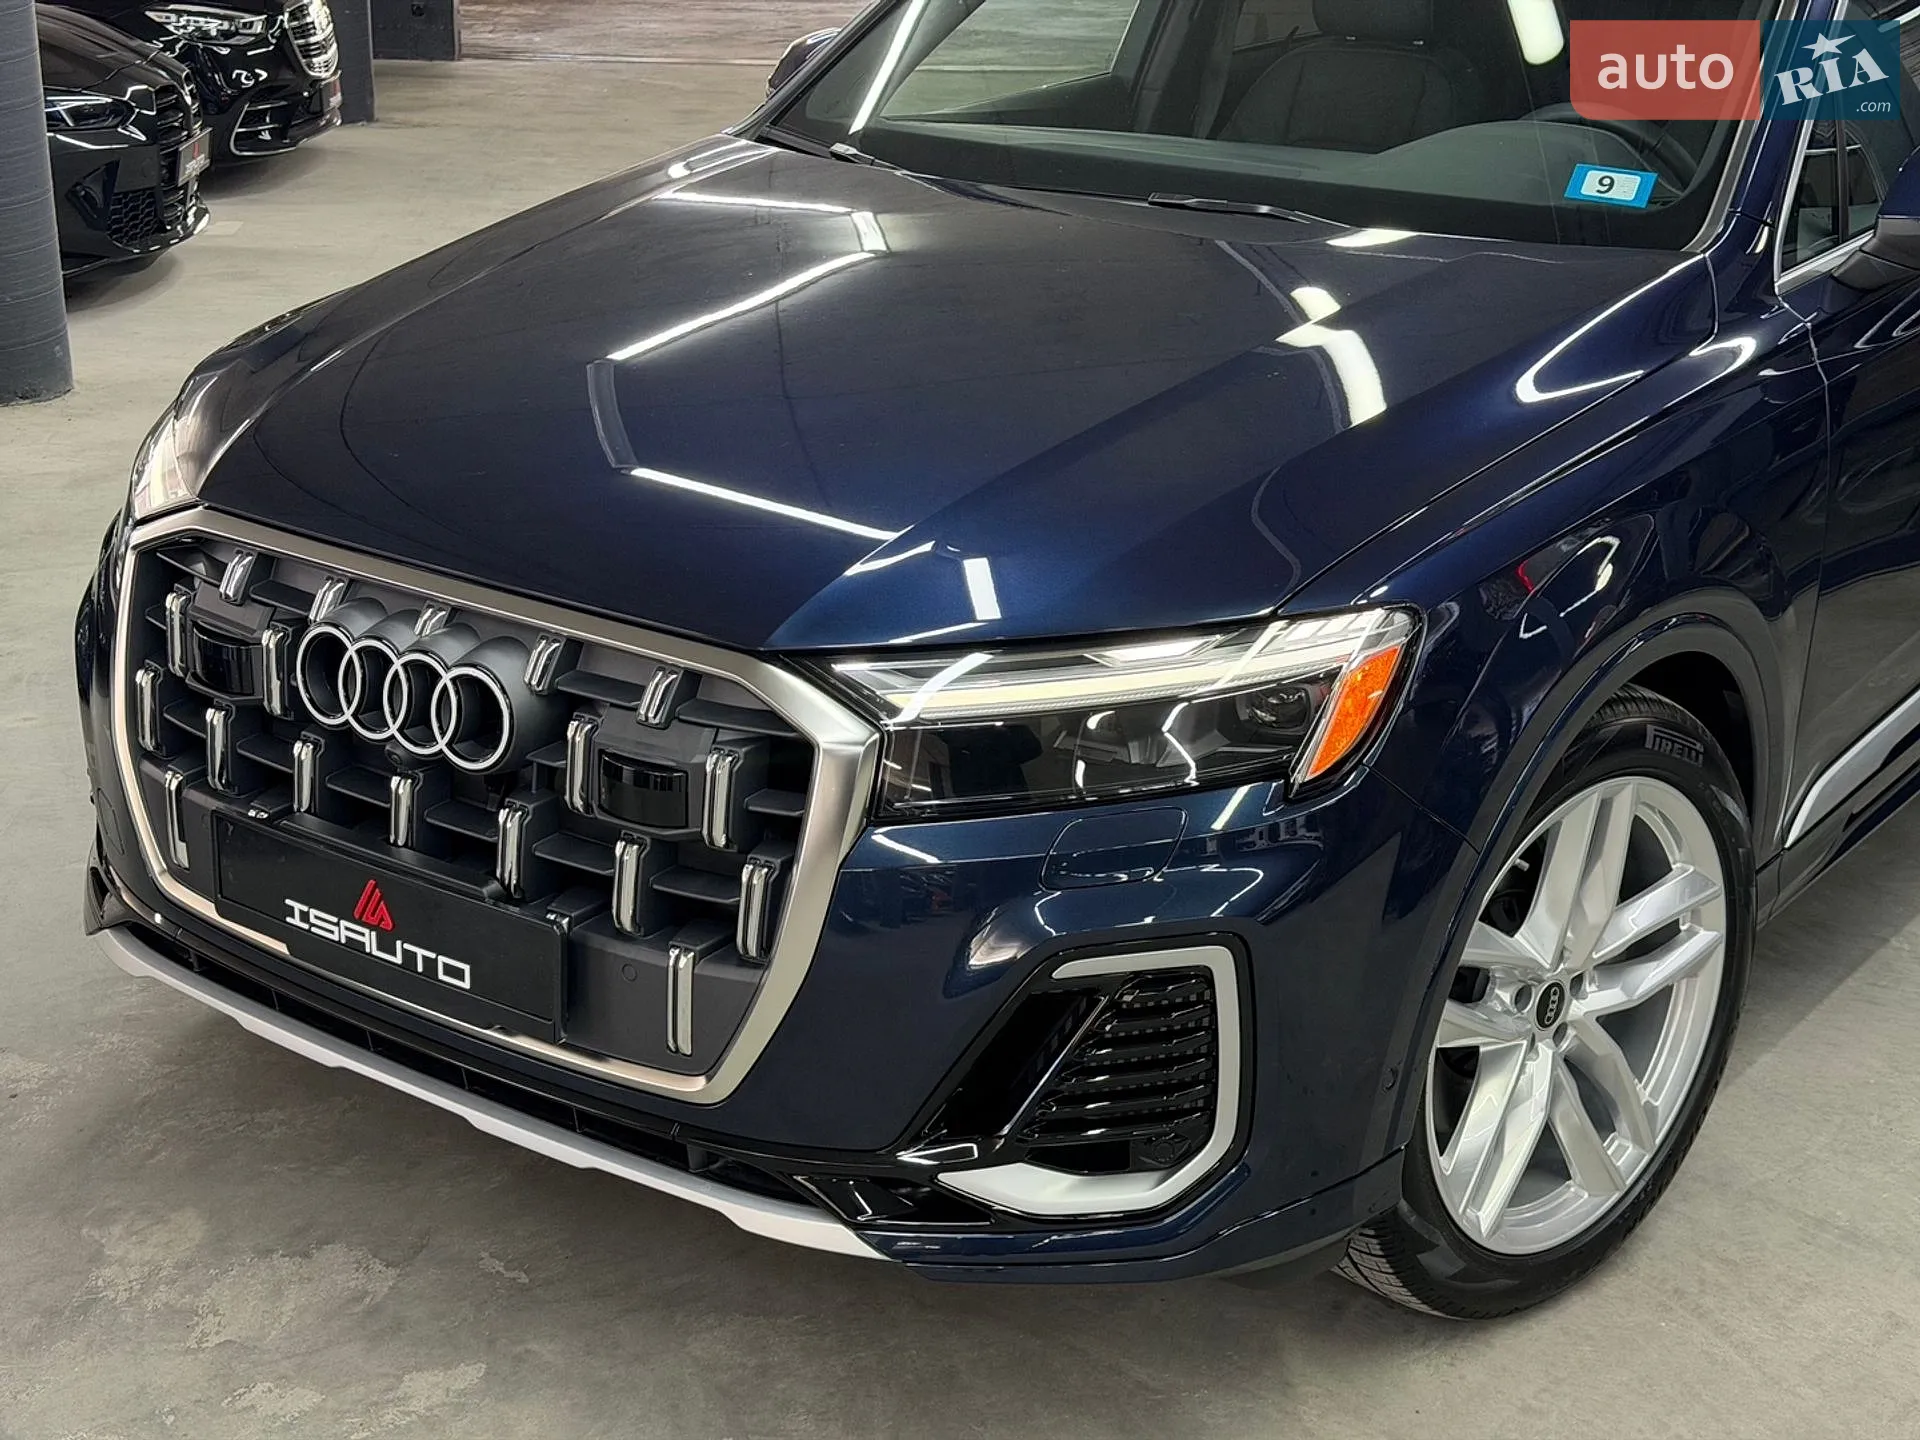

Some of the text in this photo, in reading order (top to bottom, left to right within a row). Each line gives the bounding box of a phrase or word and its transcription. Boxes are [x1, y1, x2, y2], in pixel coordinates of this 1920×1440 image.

[1596, 175, 1615, 194] 9
[1644, 723, 1704, 767] PIRELLI
[284, 898, 471, 990] ISAUTO
